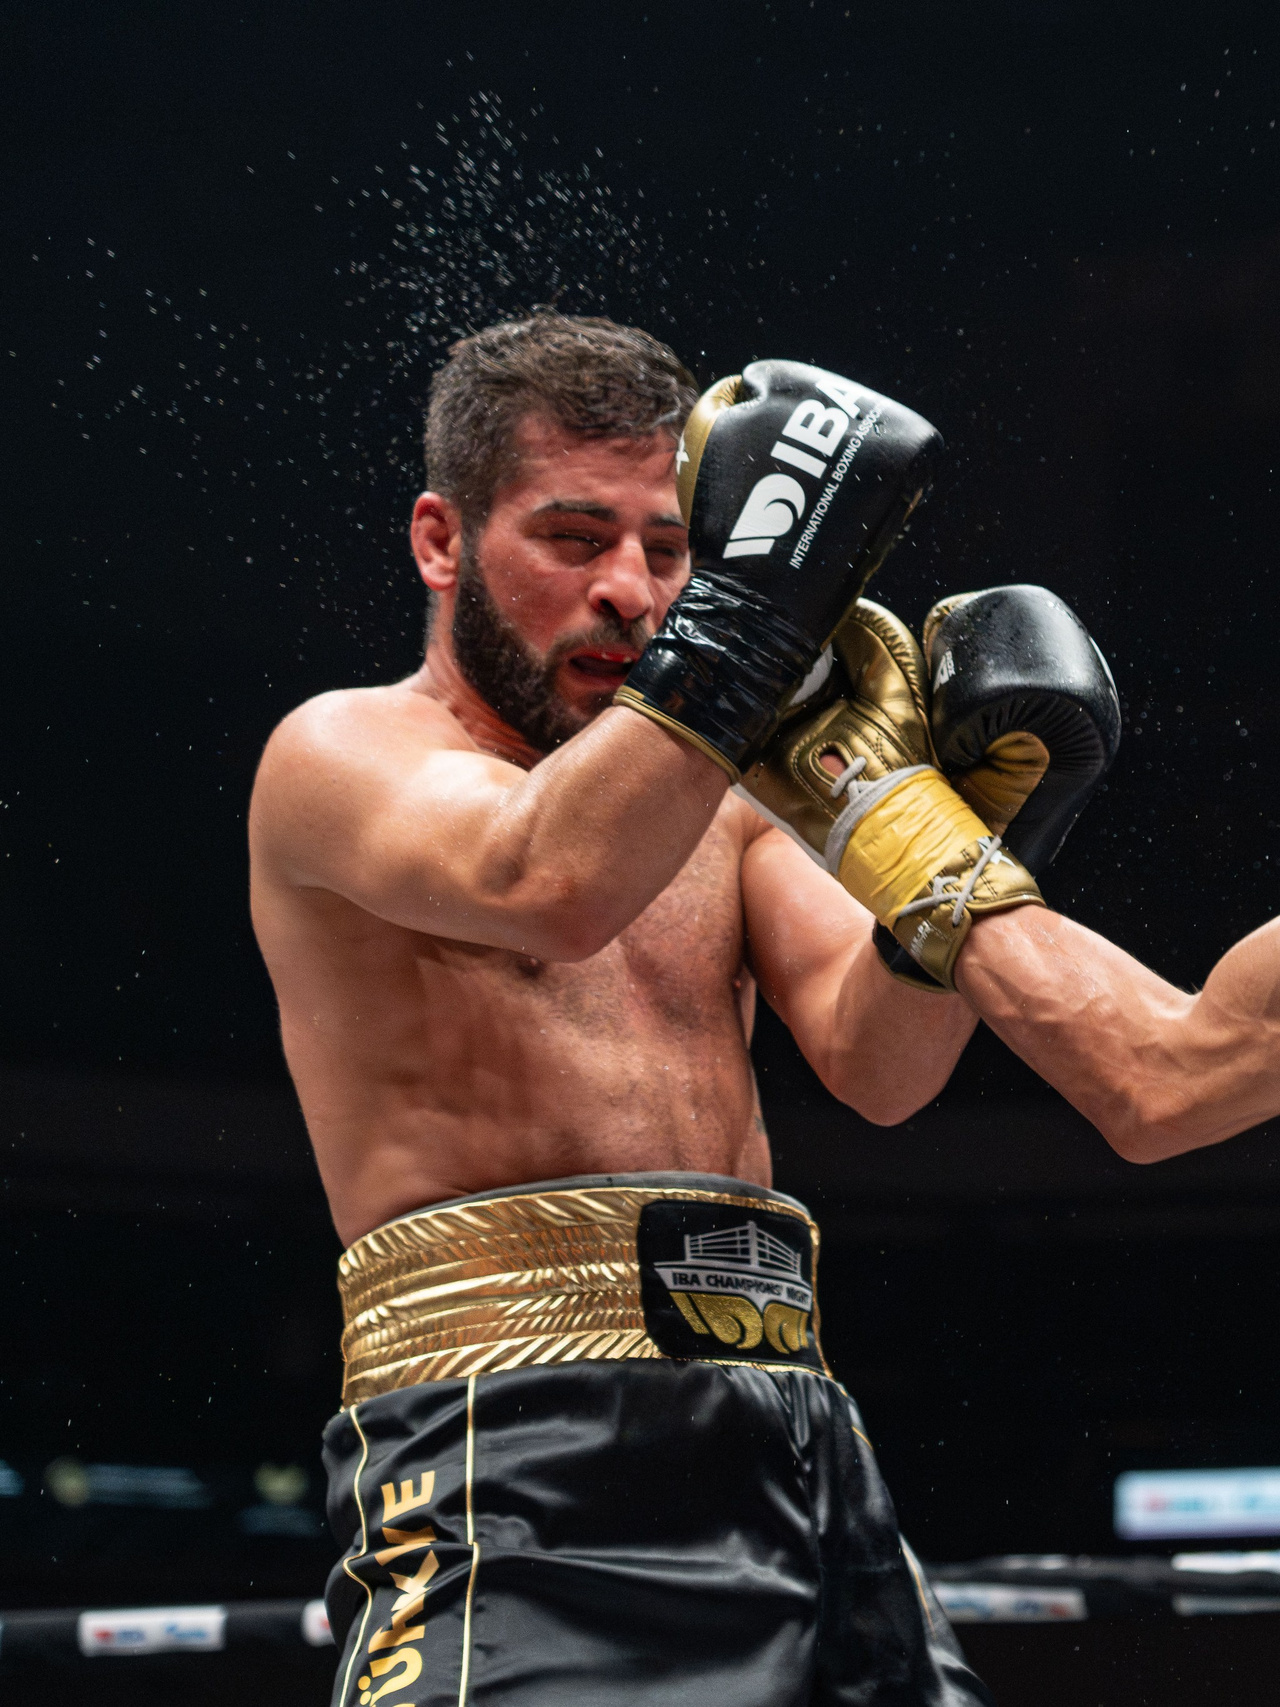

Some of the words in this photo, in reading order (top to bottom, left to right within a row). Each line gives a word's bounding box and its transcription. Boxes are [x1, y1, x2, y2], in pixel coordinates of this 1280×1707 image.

[789, 483, 840, 569] INTERNATIONAL
[831, 437, 862, 488] BOXING
[672, 1271, 701, 1286] IBA
